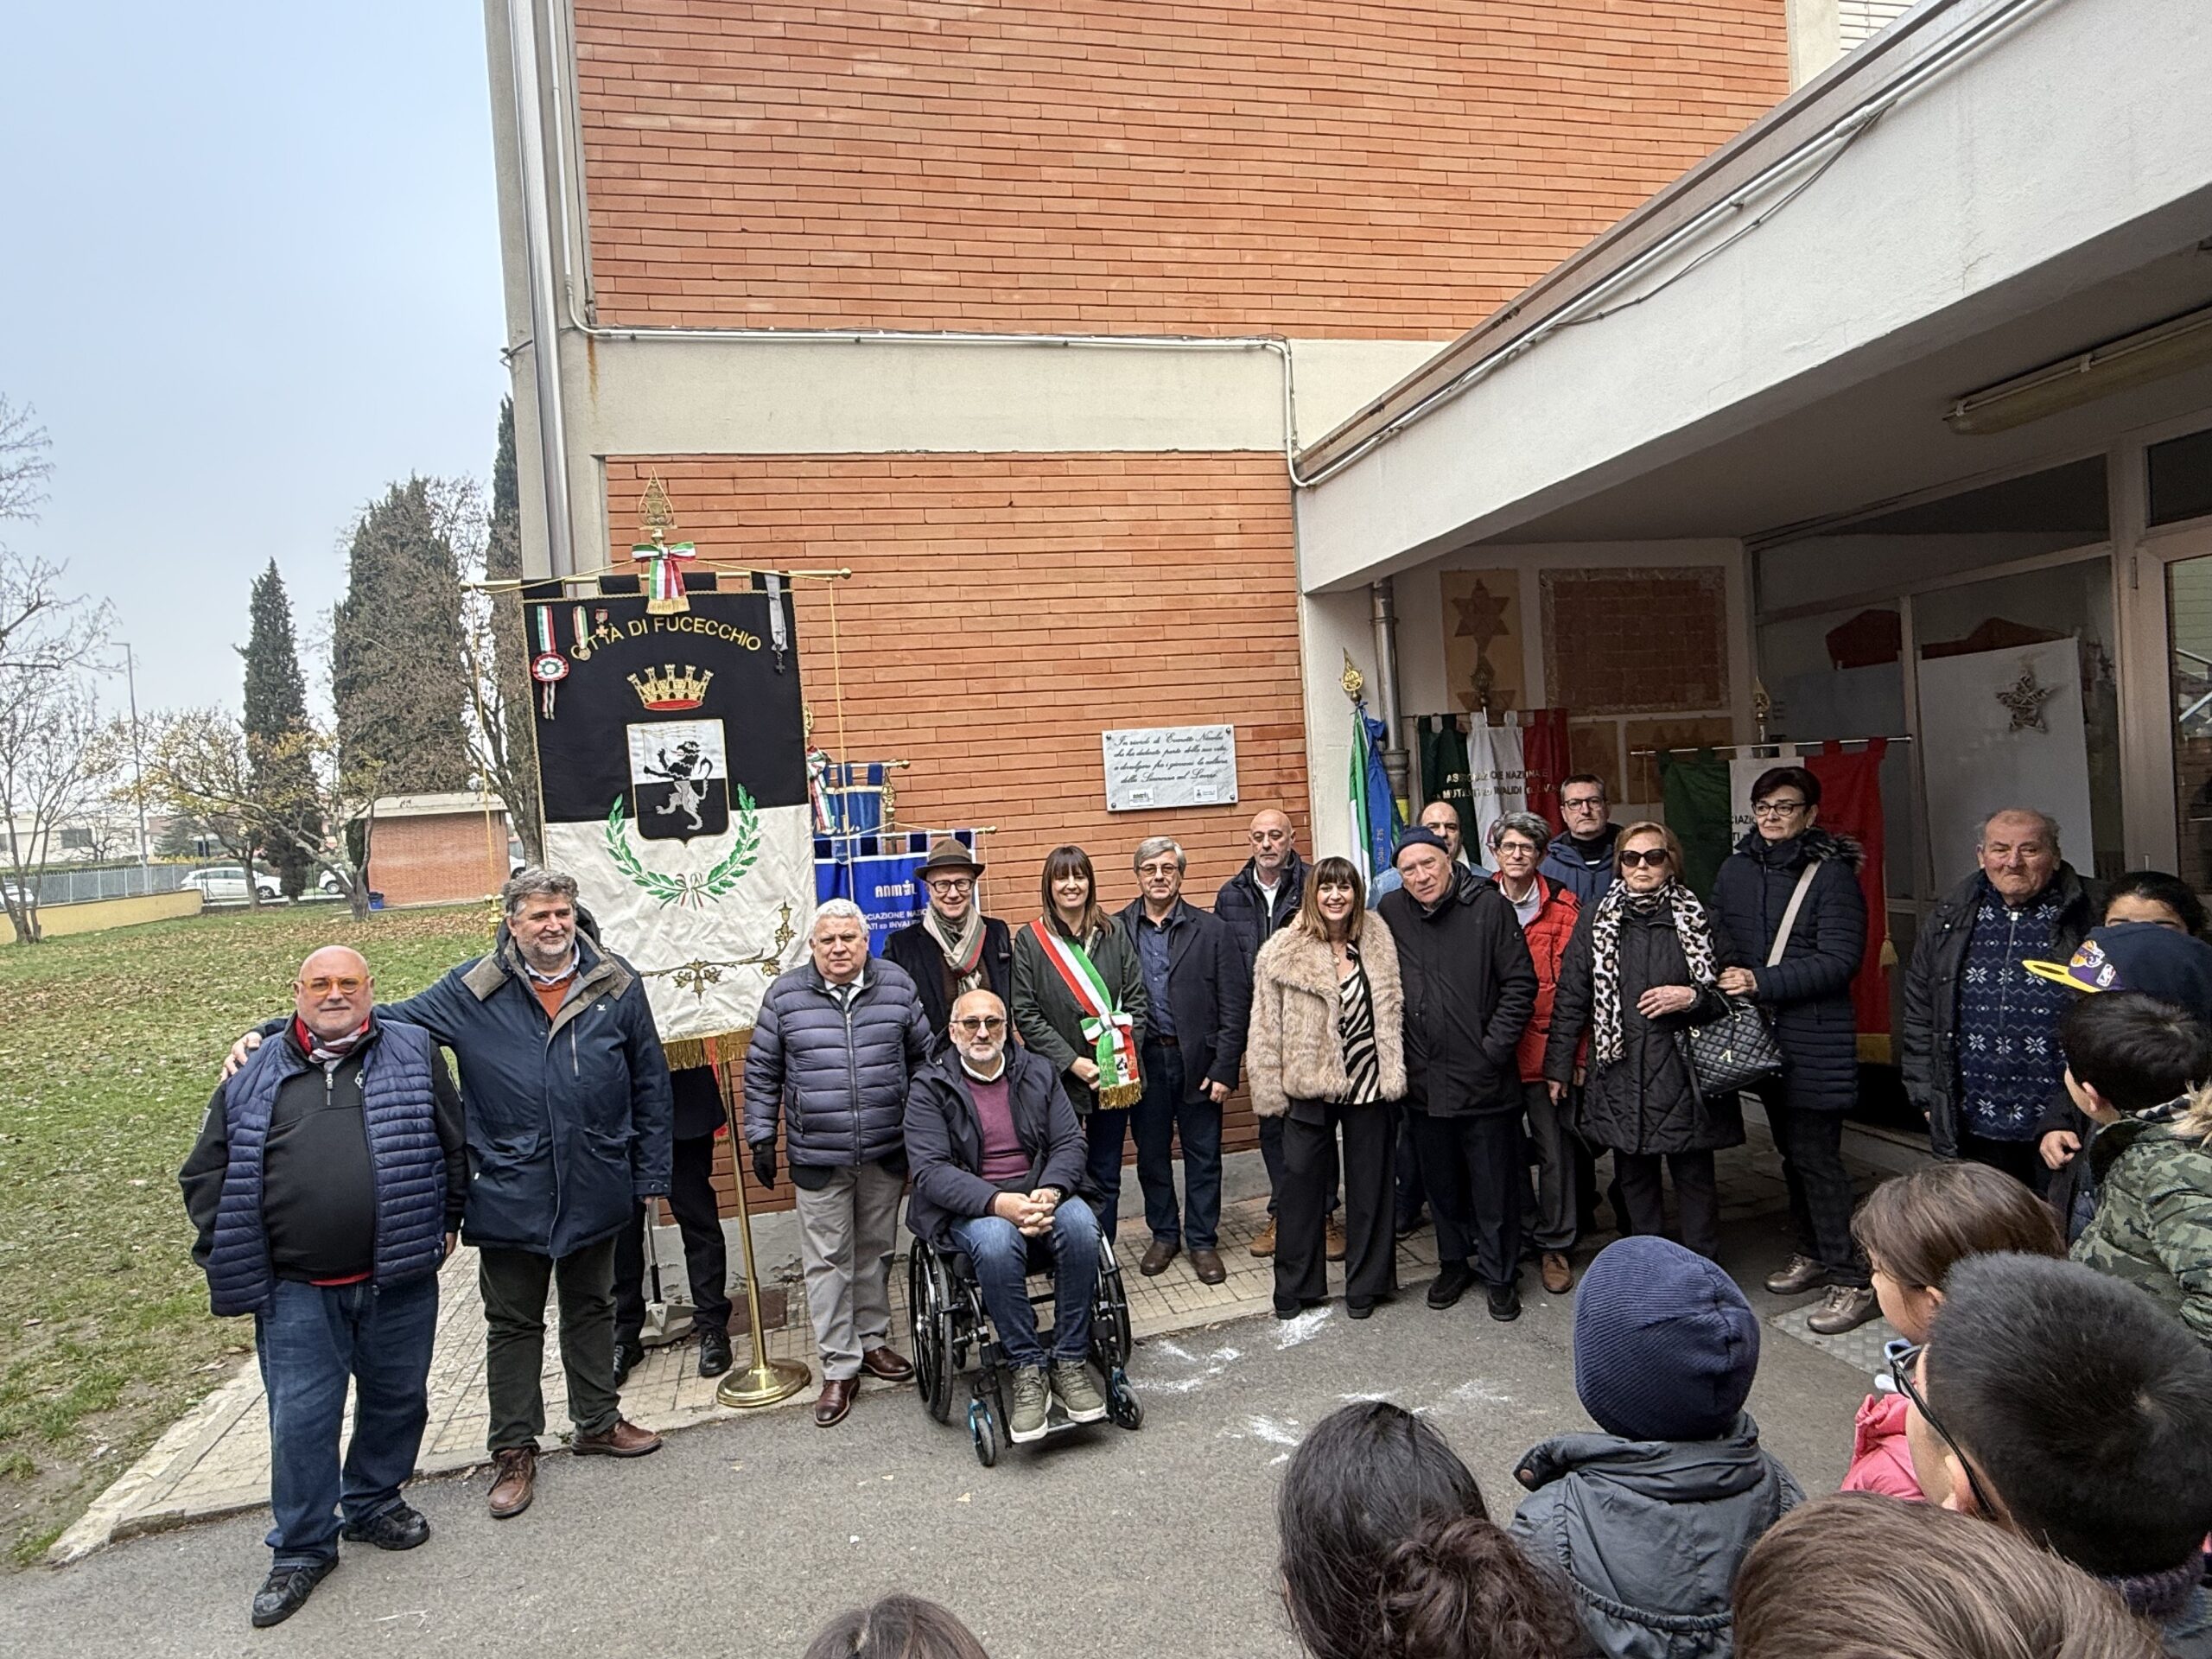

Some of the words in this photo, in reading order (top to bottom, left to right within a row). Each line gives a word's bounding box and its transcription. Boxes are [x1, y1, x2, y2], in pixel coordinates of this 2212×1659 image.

[570, 622, 625, 659] CTÀ
[628, 620, 648, 637] DI
[653, 616, 761, 652] FUCECCHIO
